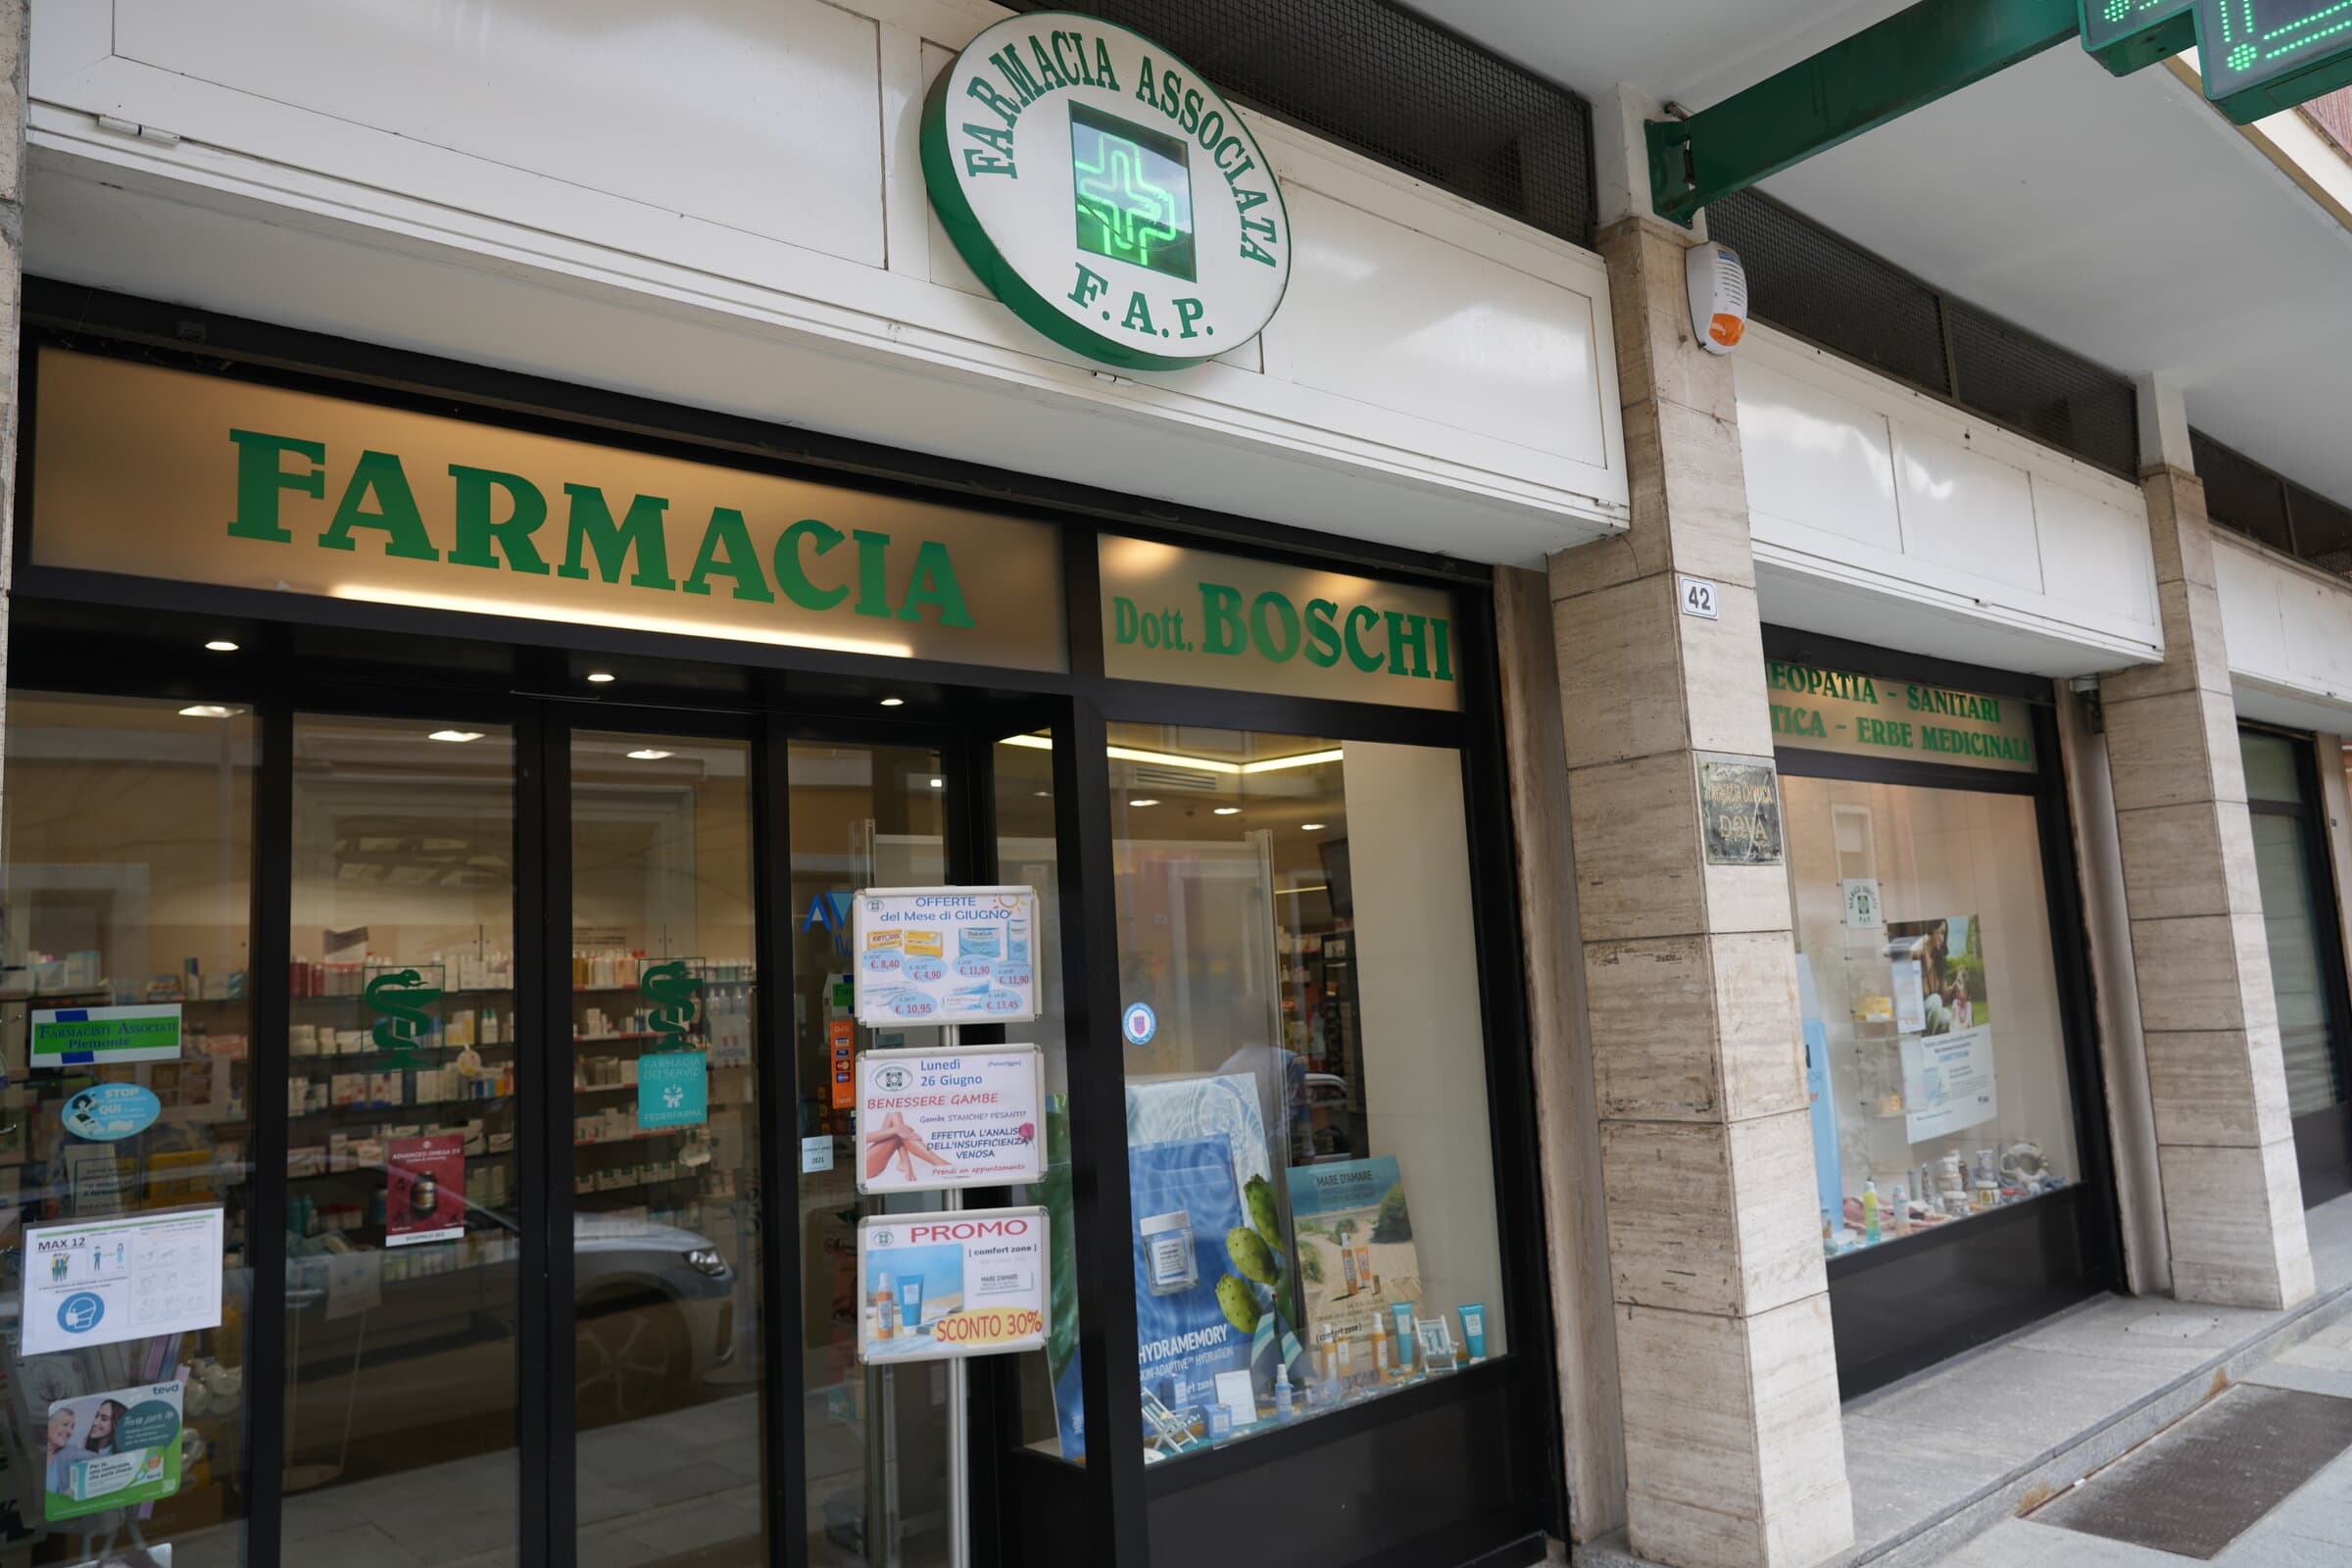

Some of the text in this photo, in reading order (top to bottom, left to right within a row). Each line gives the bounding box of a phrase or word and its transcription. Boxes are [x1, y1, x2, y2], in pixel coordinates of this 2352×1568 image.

[962, 30, 1277, 268] FARMACIA ASSOCIATA
[1067, 263, 1214, 339] F.A.P.
[227, 428, 975, 628] FARMACIA
[1689, 586, 1711, 611] 42
[1113, 582, 1454, 681] Dott. BOSCHI
[1766, 662, 1878, 705] EOPATIA
[1907, 685, 2000, 722] SANITARI
[1770, 705, 1827, 738] TICA
[1856, 717, 1914, 749] ERBE
[1921, 725, 2031, 761] MEDICINALI
[915, 896, 976, 907] OFFERTE
[880, 909, 1010, 921] del Mese di GIUGNO
[69, 1038, 130, 1049] Piemonte
[644, 1058, 701, 1069] FARMACIA
[920, 1058, 960, 1071] Lunedì
[920, 1075, 982, 1088] 26 Giugno
[105, 1088, 140, 1099] STOP
[867, 1095, 946, 1109] BENESSERE
[951, 1093, 1000, 1105] GAMBE
[919, 1110, 1027, 1124] Gambe STANCHE? PESANTI?
[931, 1130, 976, 1140] EFFETTUA
[926, 1137, 1029, 1151] DELL'INSUFFICIENZA
[956, 1150, 996, 1159] VENOSA
[933, 1167, 957, 1176] Prendi
[971, 1163, 1026, 1175] appuntamento
[911, 1219, 1028, 1243] PROMO
[38, 1237, 86, 1251] MAX 12
[974, 1247, 1008, 1255] comfort
[1011, 1245, 1032, 1253] zone
[936, 1309, 1043, 1344] SCONTO 30%
[1139, 1323, 1228, 1365] HYDRAMEMORY
[153, 1384, 179, 1395] teva
